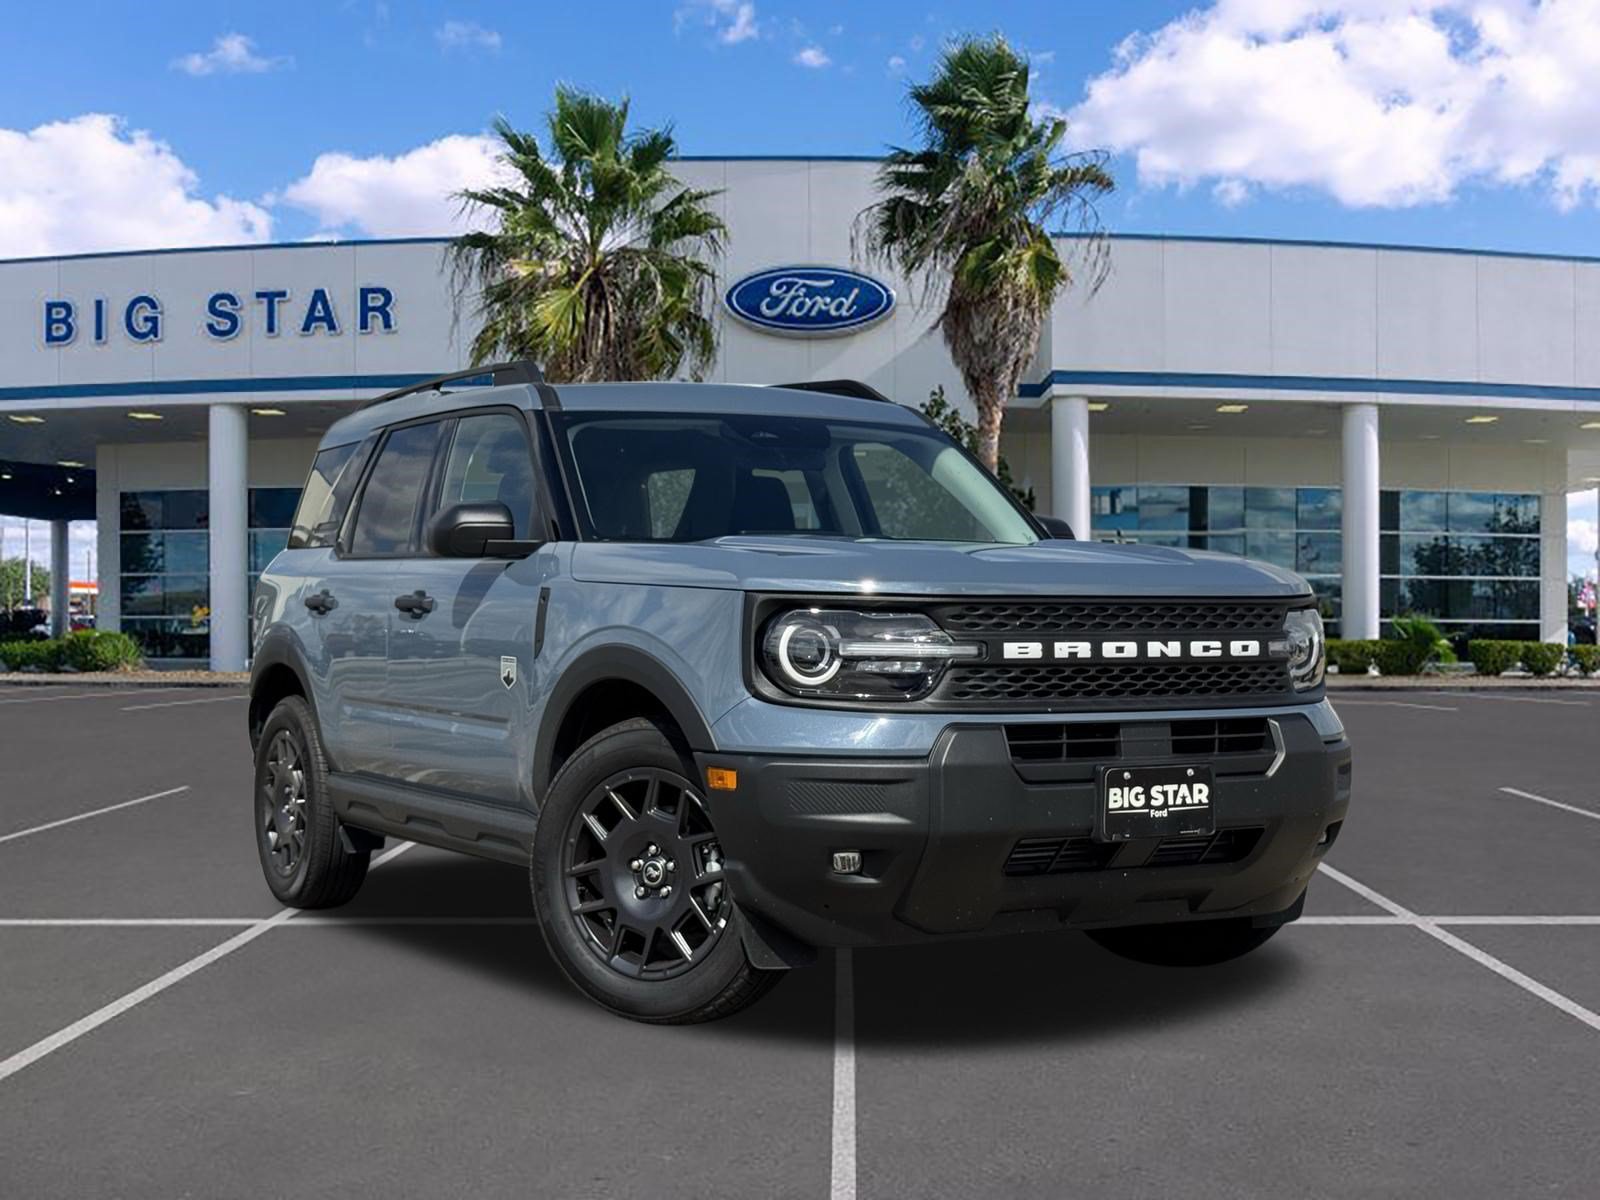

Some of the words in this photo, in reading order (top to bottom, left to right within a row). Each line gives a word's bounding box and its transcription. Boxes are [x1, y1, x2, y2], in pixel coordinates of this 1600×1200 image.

[759, 277, 859, 318] Ford
[44, 295, 163, 344] BIG
[206, 287, 397, 340] STAR
[1003, 640, 1260, 658] BRONCO
[1108, 786, 1146, 809] BIG
[1150, 783, 1209, 806] STAR
[1150, 808, 1168, 818] Ford
